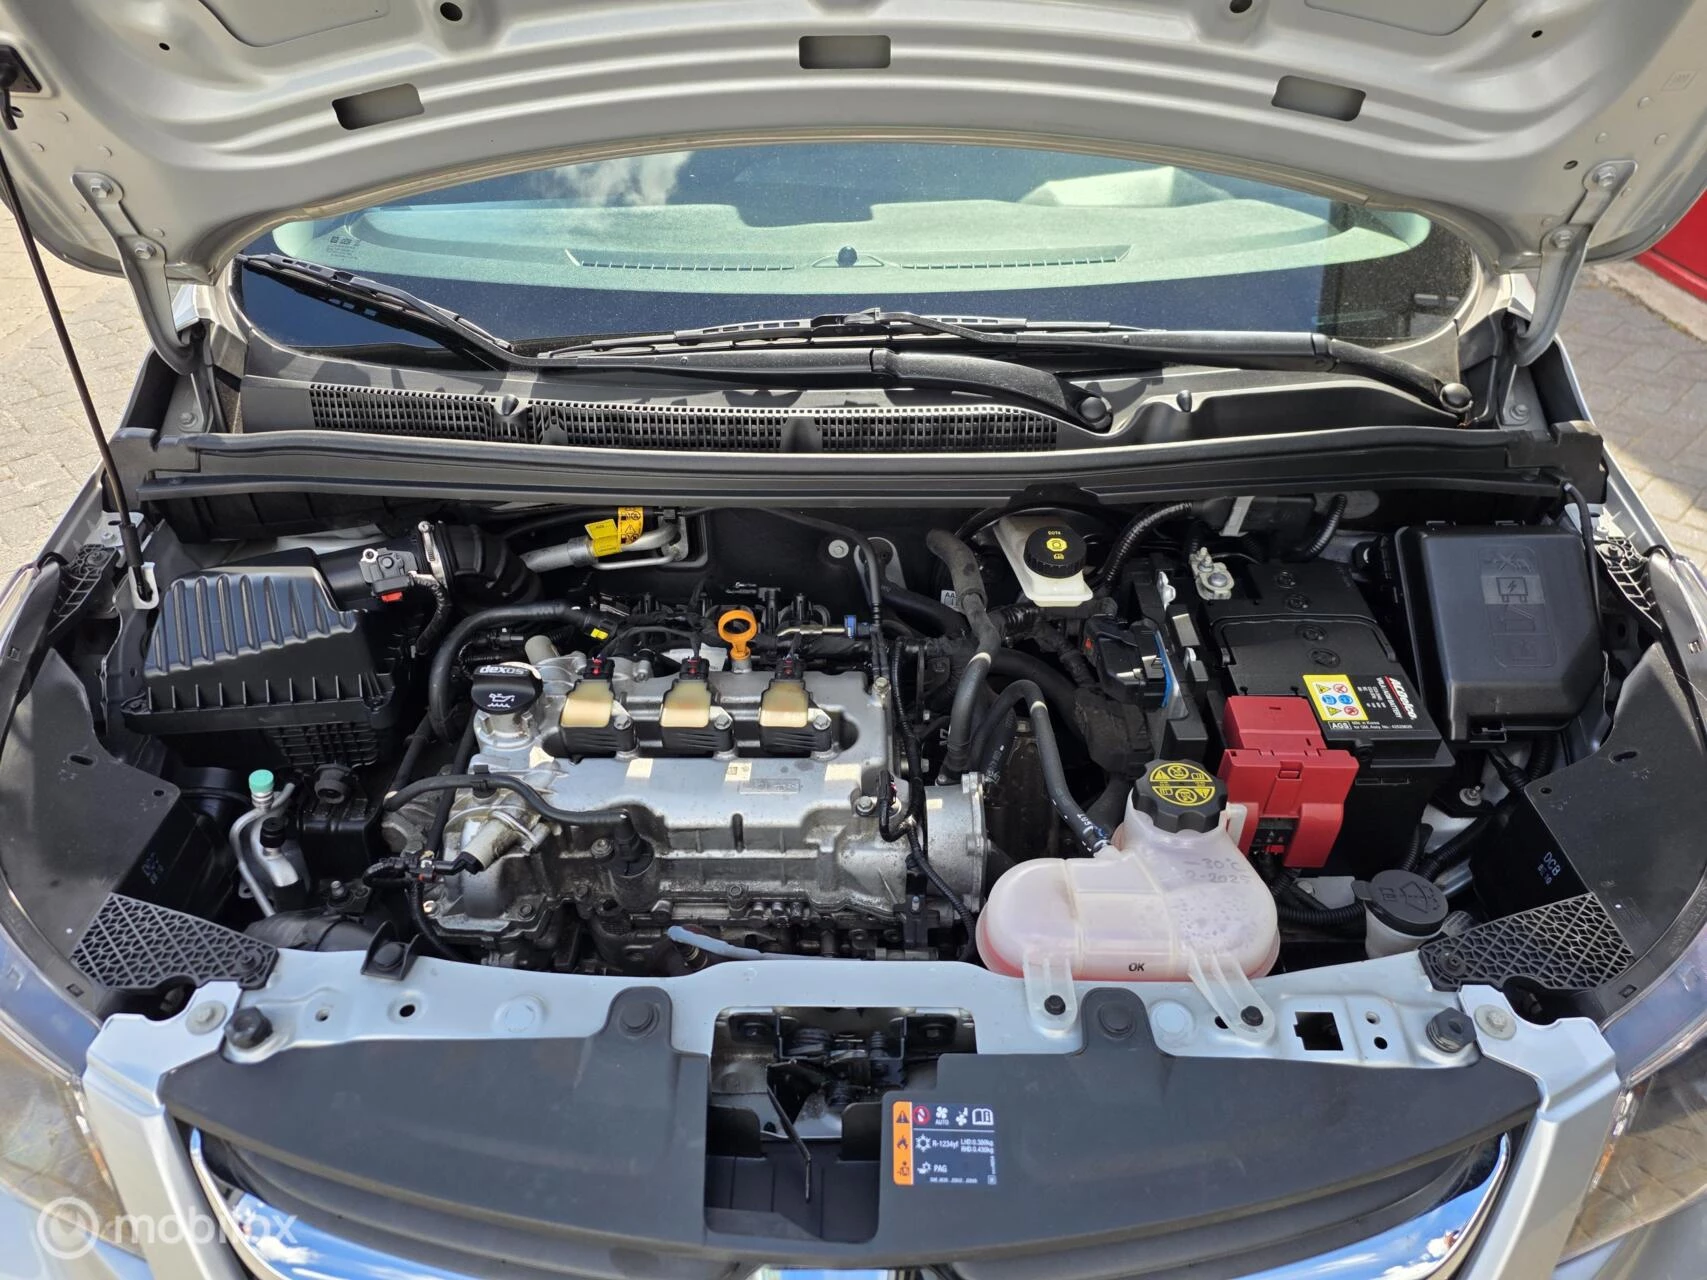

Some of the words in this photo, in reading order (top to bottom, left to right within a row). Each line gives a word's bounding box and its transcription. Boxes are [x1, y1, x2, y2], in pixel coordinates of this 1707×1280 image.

[479, 664, 526, 675] dexos
[1389, 677, 1418, 720] ACDelco
[1128, 962, 1145, 972] OK
[932, 1140, 959, 1149] R-1234yf
[933, 1164, 948, 1173] PAG
